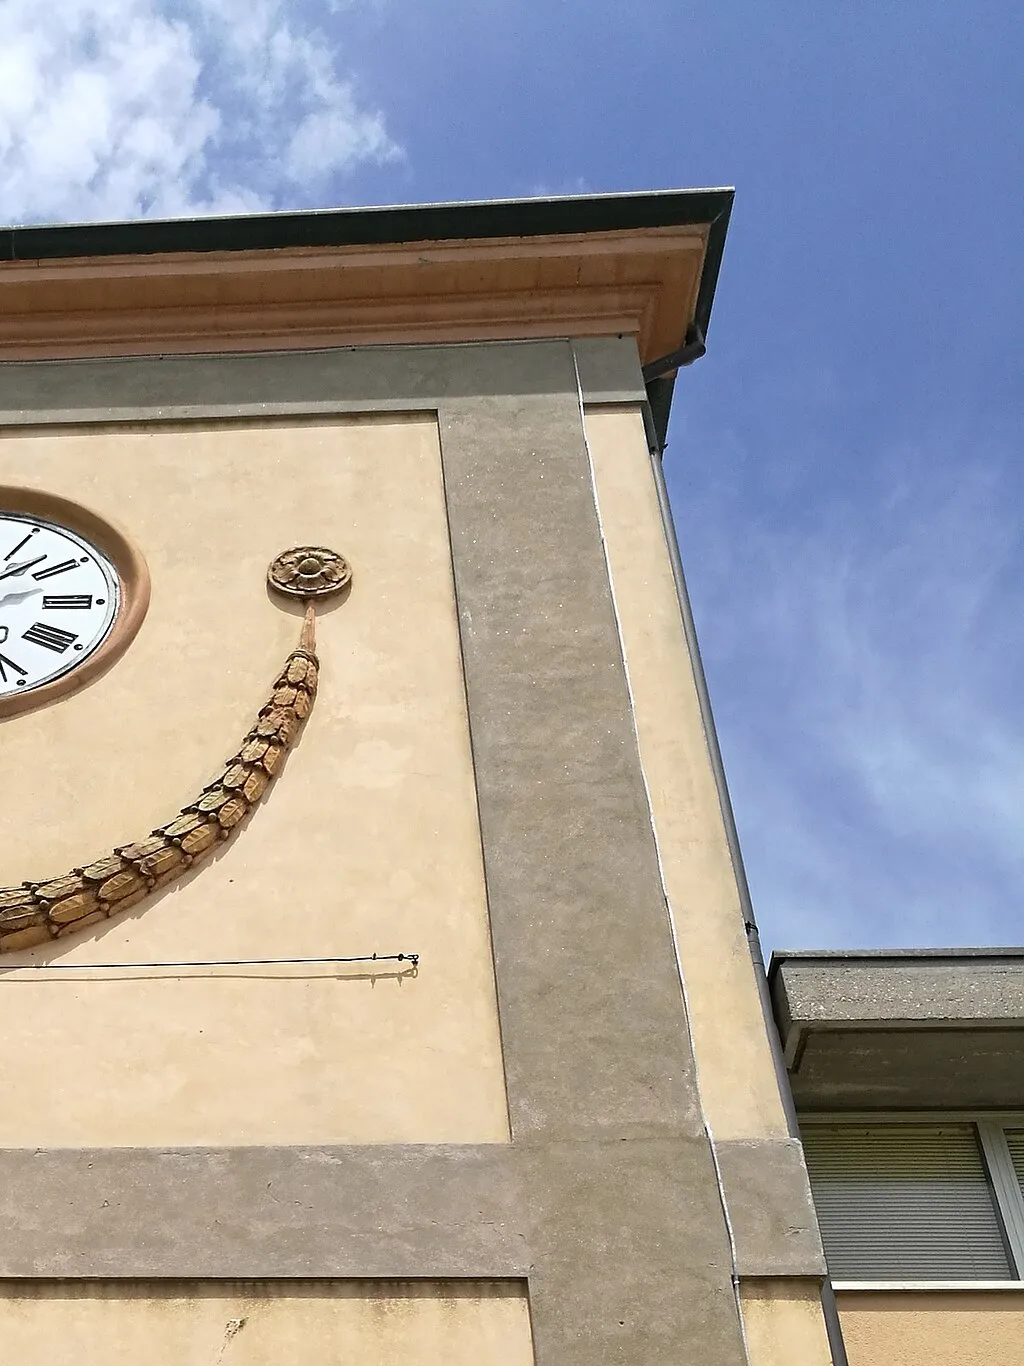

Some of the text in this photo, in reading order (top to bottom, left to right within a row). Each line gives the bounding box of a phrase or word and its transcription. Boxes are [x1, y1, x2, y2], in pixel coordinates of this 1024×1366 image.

[31, 558, 80, 581] II
[42, 594, 93, 609] III
[21, 622, 79, 654] IIII
